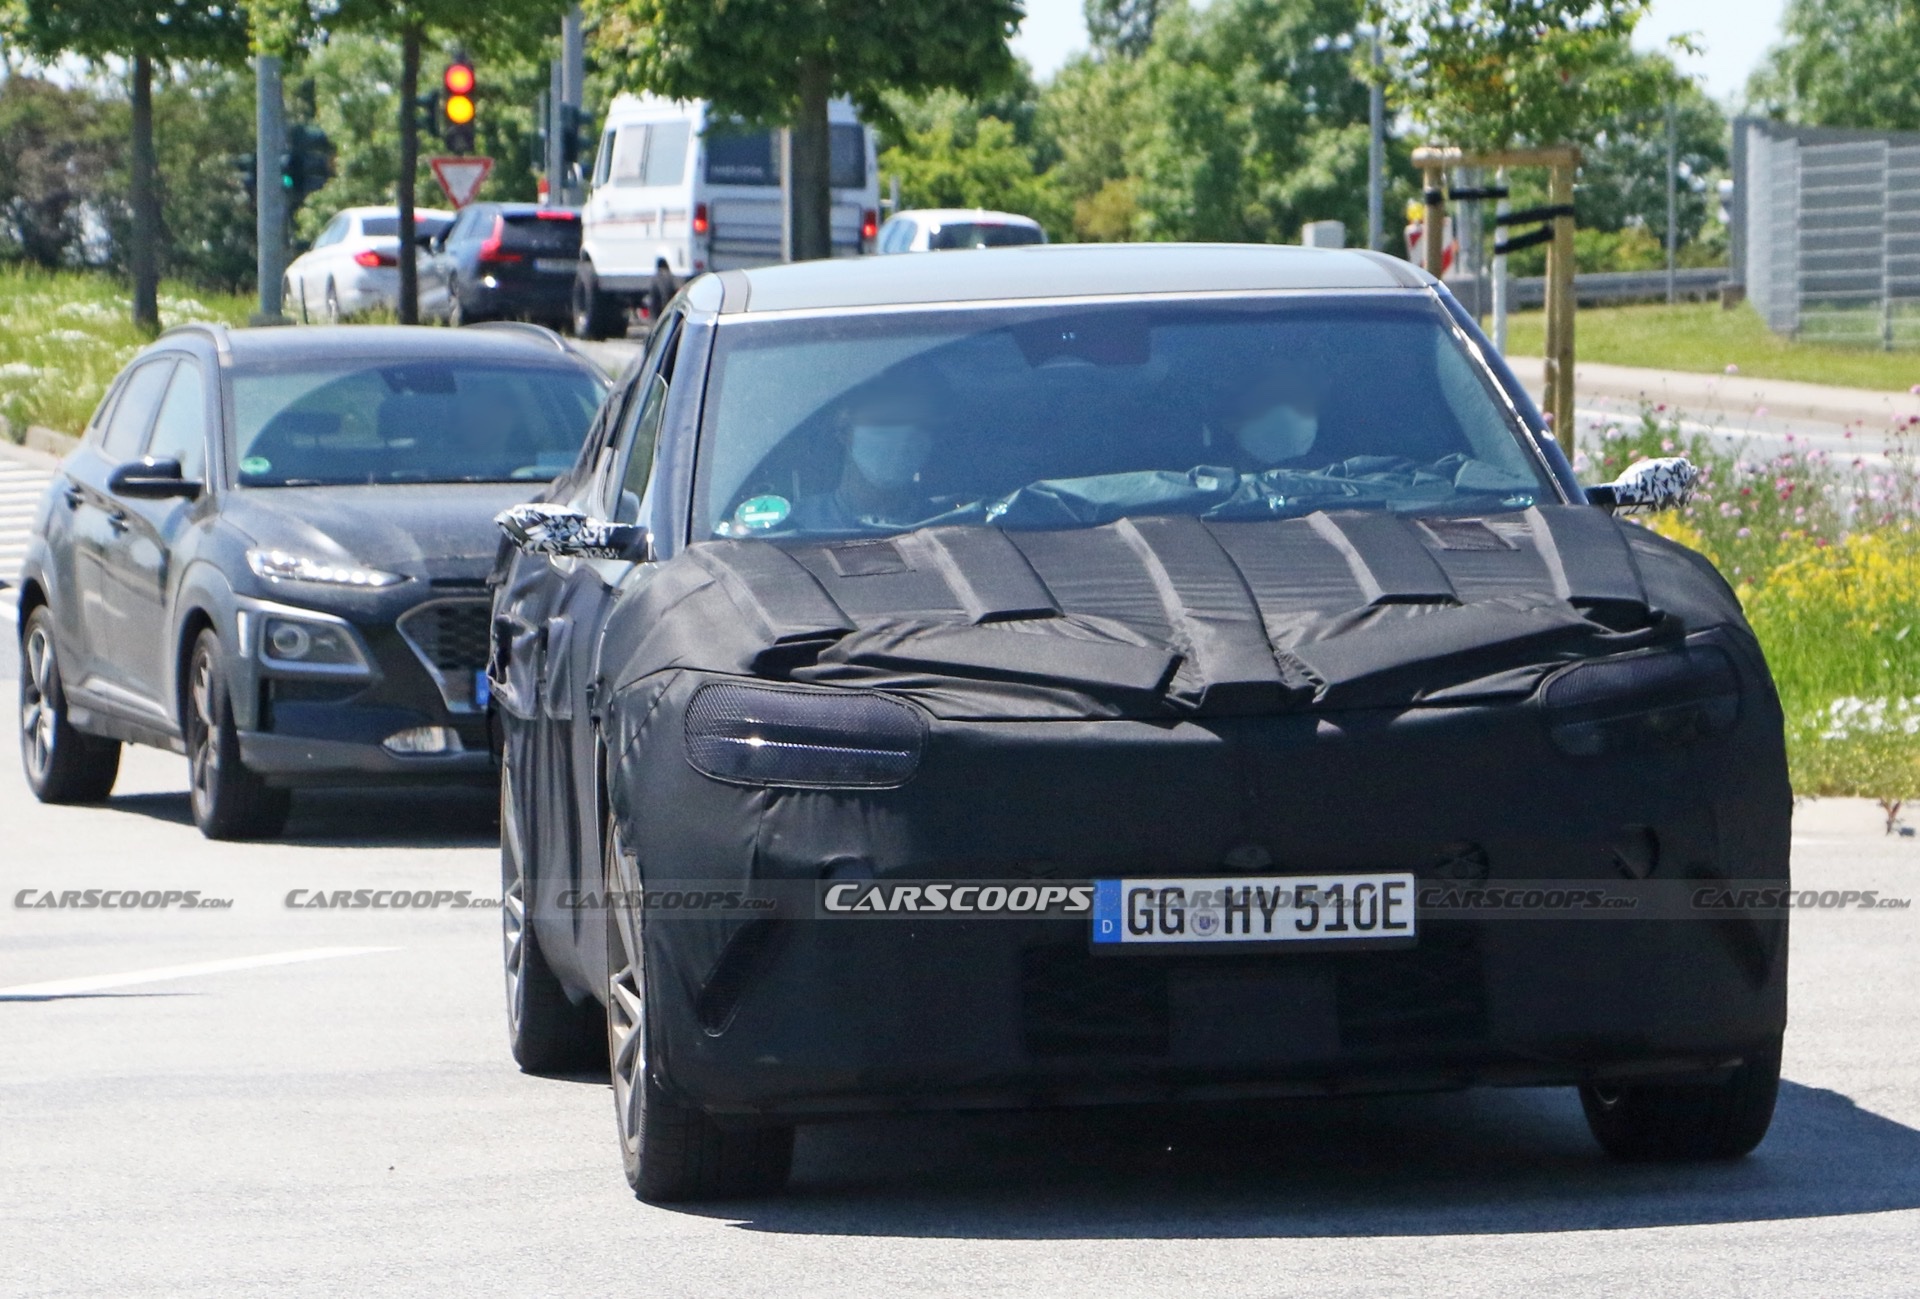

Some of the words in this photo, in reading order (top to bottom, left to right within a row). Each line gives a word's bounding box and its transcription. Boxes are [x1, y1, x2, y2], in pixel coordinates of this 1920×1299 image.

[1127, 886, 1186, 936] GG
[1224, 884, 1282, 935] HY
[1294, 881, 1408, 932] 510E
[1101, 919, 1114, 934] D
